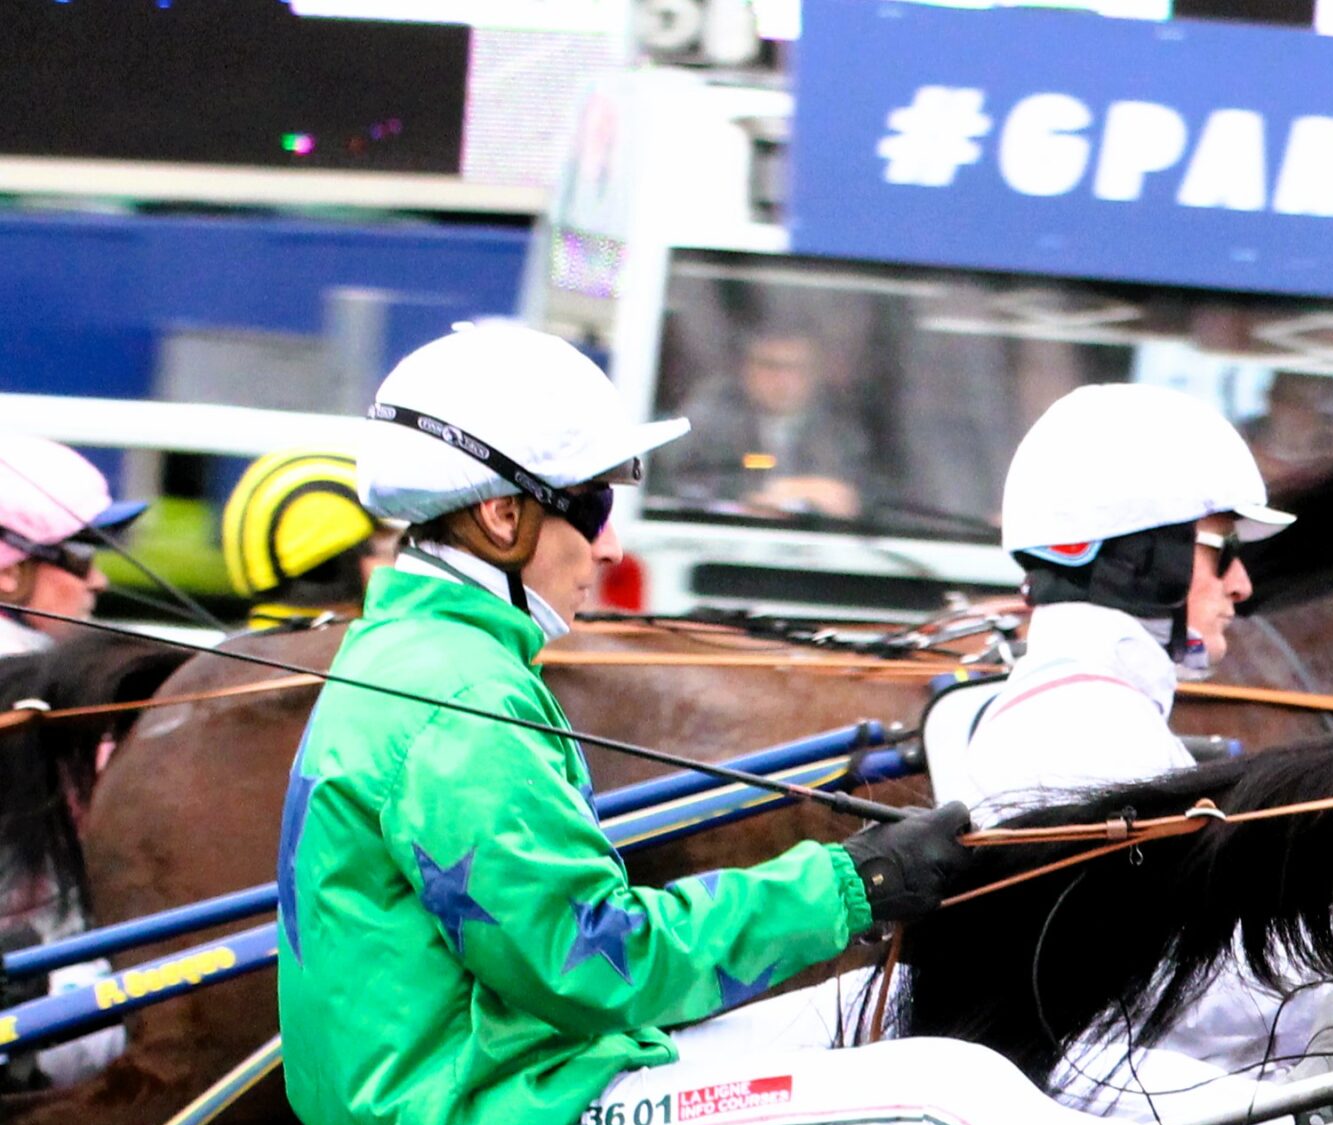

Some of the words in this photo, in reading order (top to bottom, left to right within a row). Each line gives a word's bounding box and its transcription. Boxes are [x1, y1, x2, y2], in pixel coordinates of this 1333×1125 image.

[681, 1089, 703, 1106] LA
[704, 1081, 752, 1101] LIGNE
[681, 1102, 716, 1119] INFO
